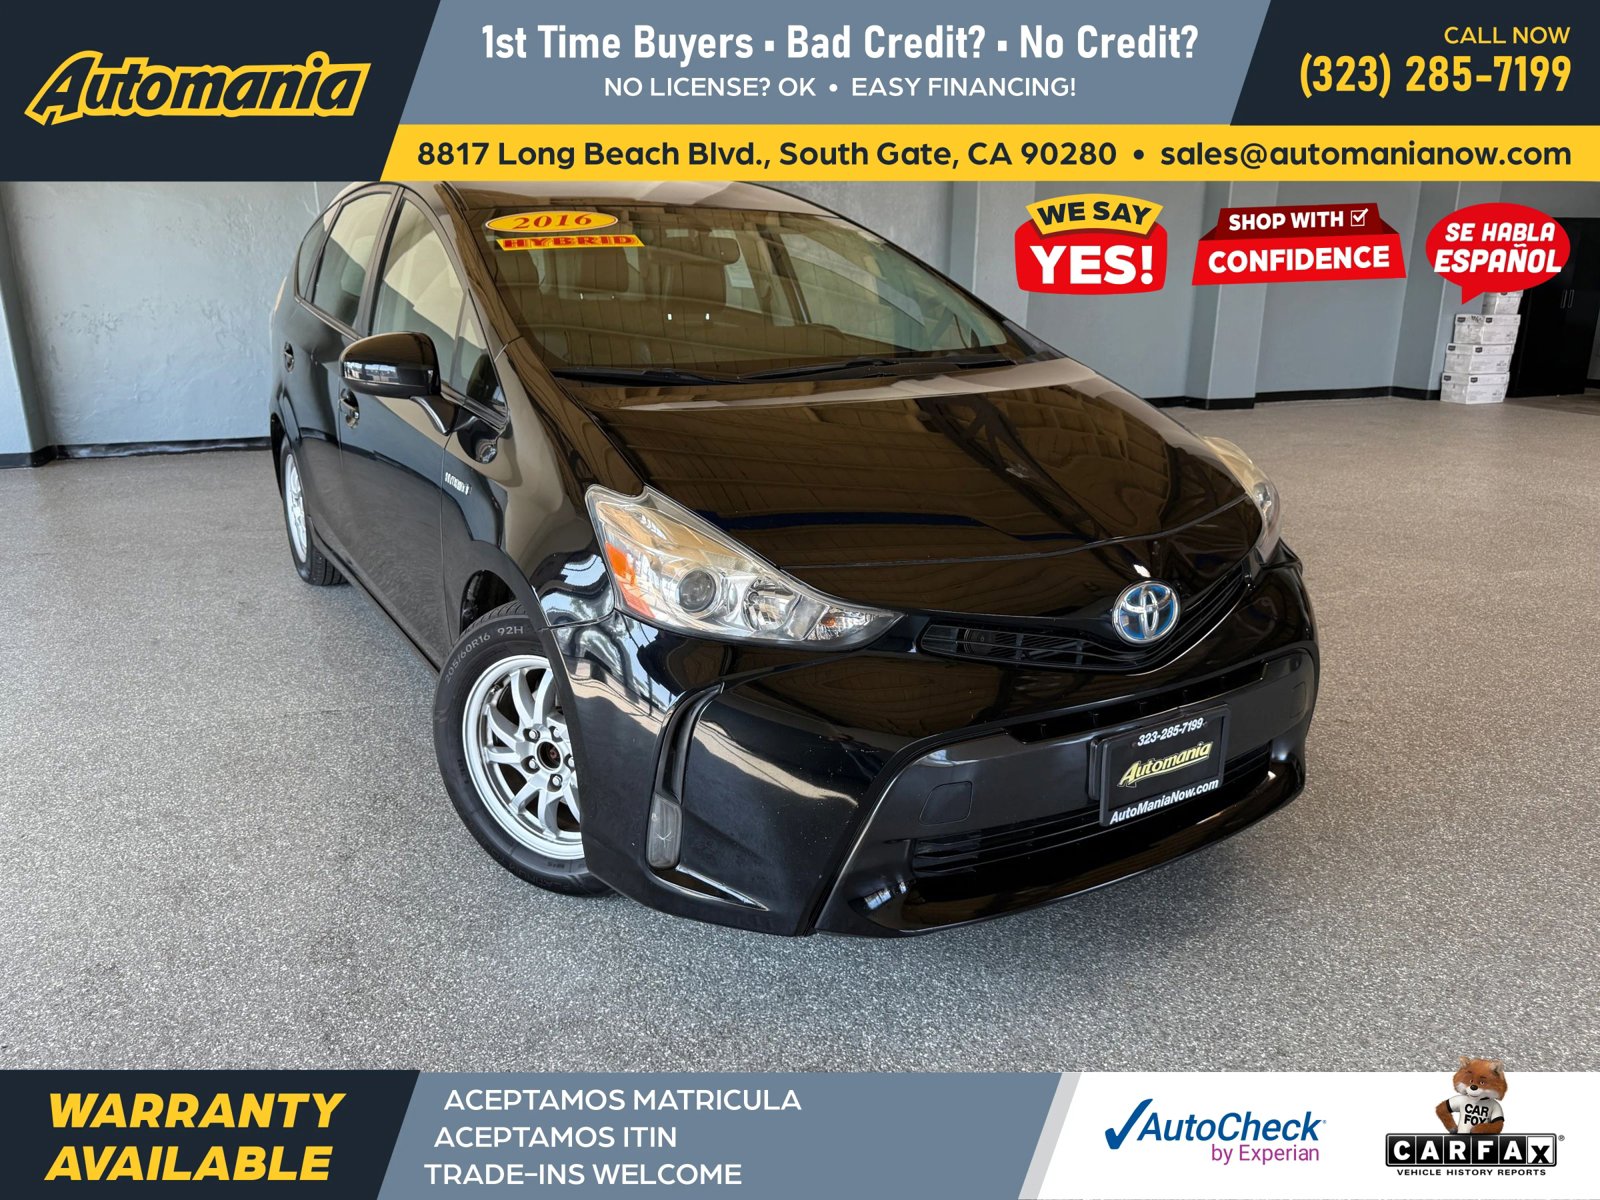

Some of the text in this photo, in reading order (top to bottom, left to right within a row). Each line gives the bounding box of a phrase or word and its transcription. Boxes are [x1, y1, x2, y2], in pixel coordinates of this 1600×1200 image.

[513, 213, 592, 230] 2016
[504, 235, 634, 248] HYBRID
[497, 626, 524, 636] 92H
[1138, 718, 1204, 746] 323-285-7199
[1117, 741, 1213, 788] Automania
[1110, 779, 1219, 824] AutoManiaNow.com
